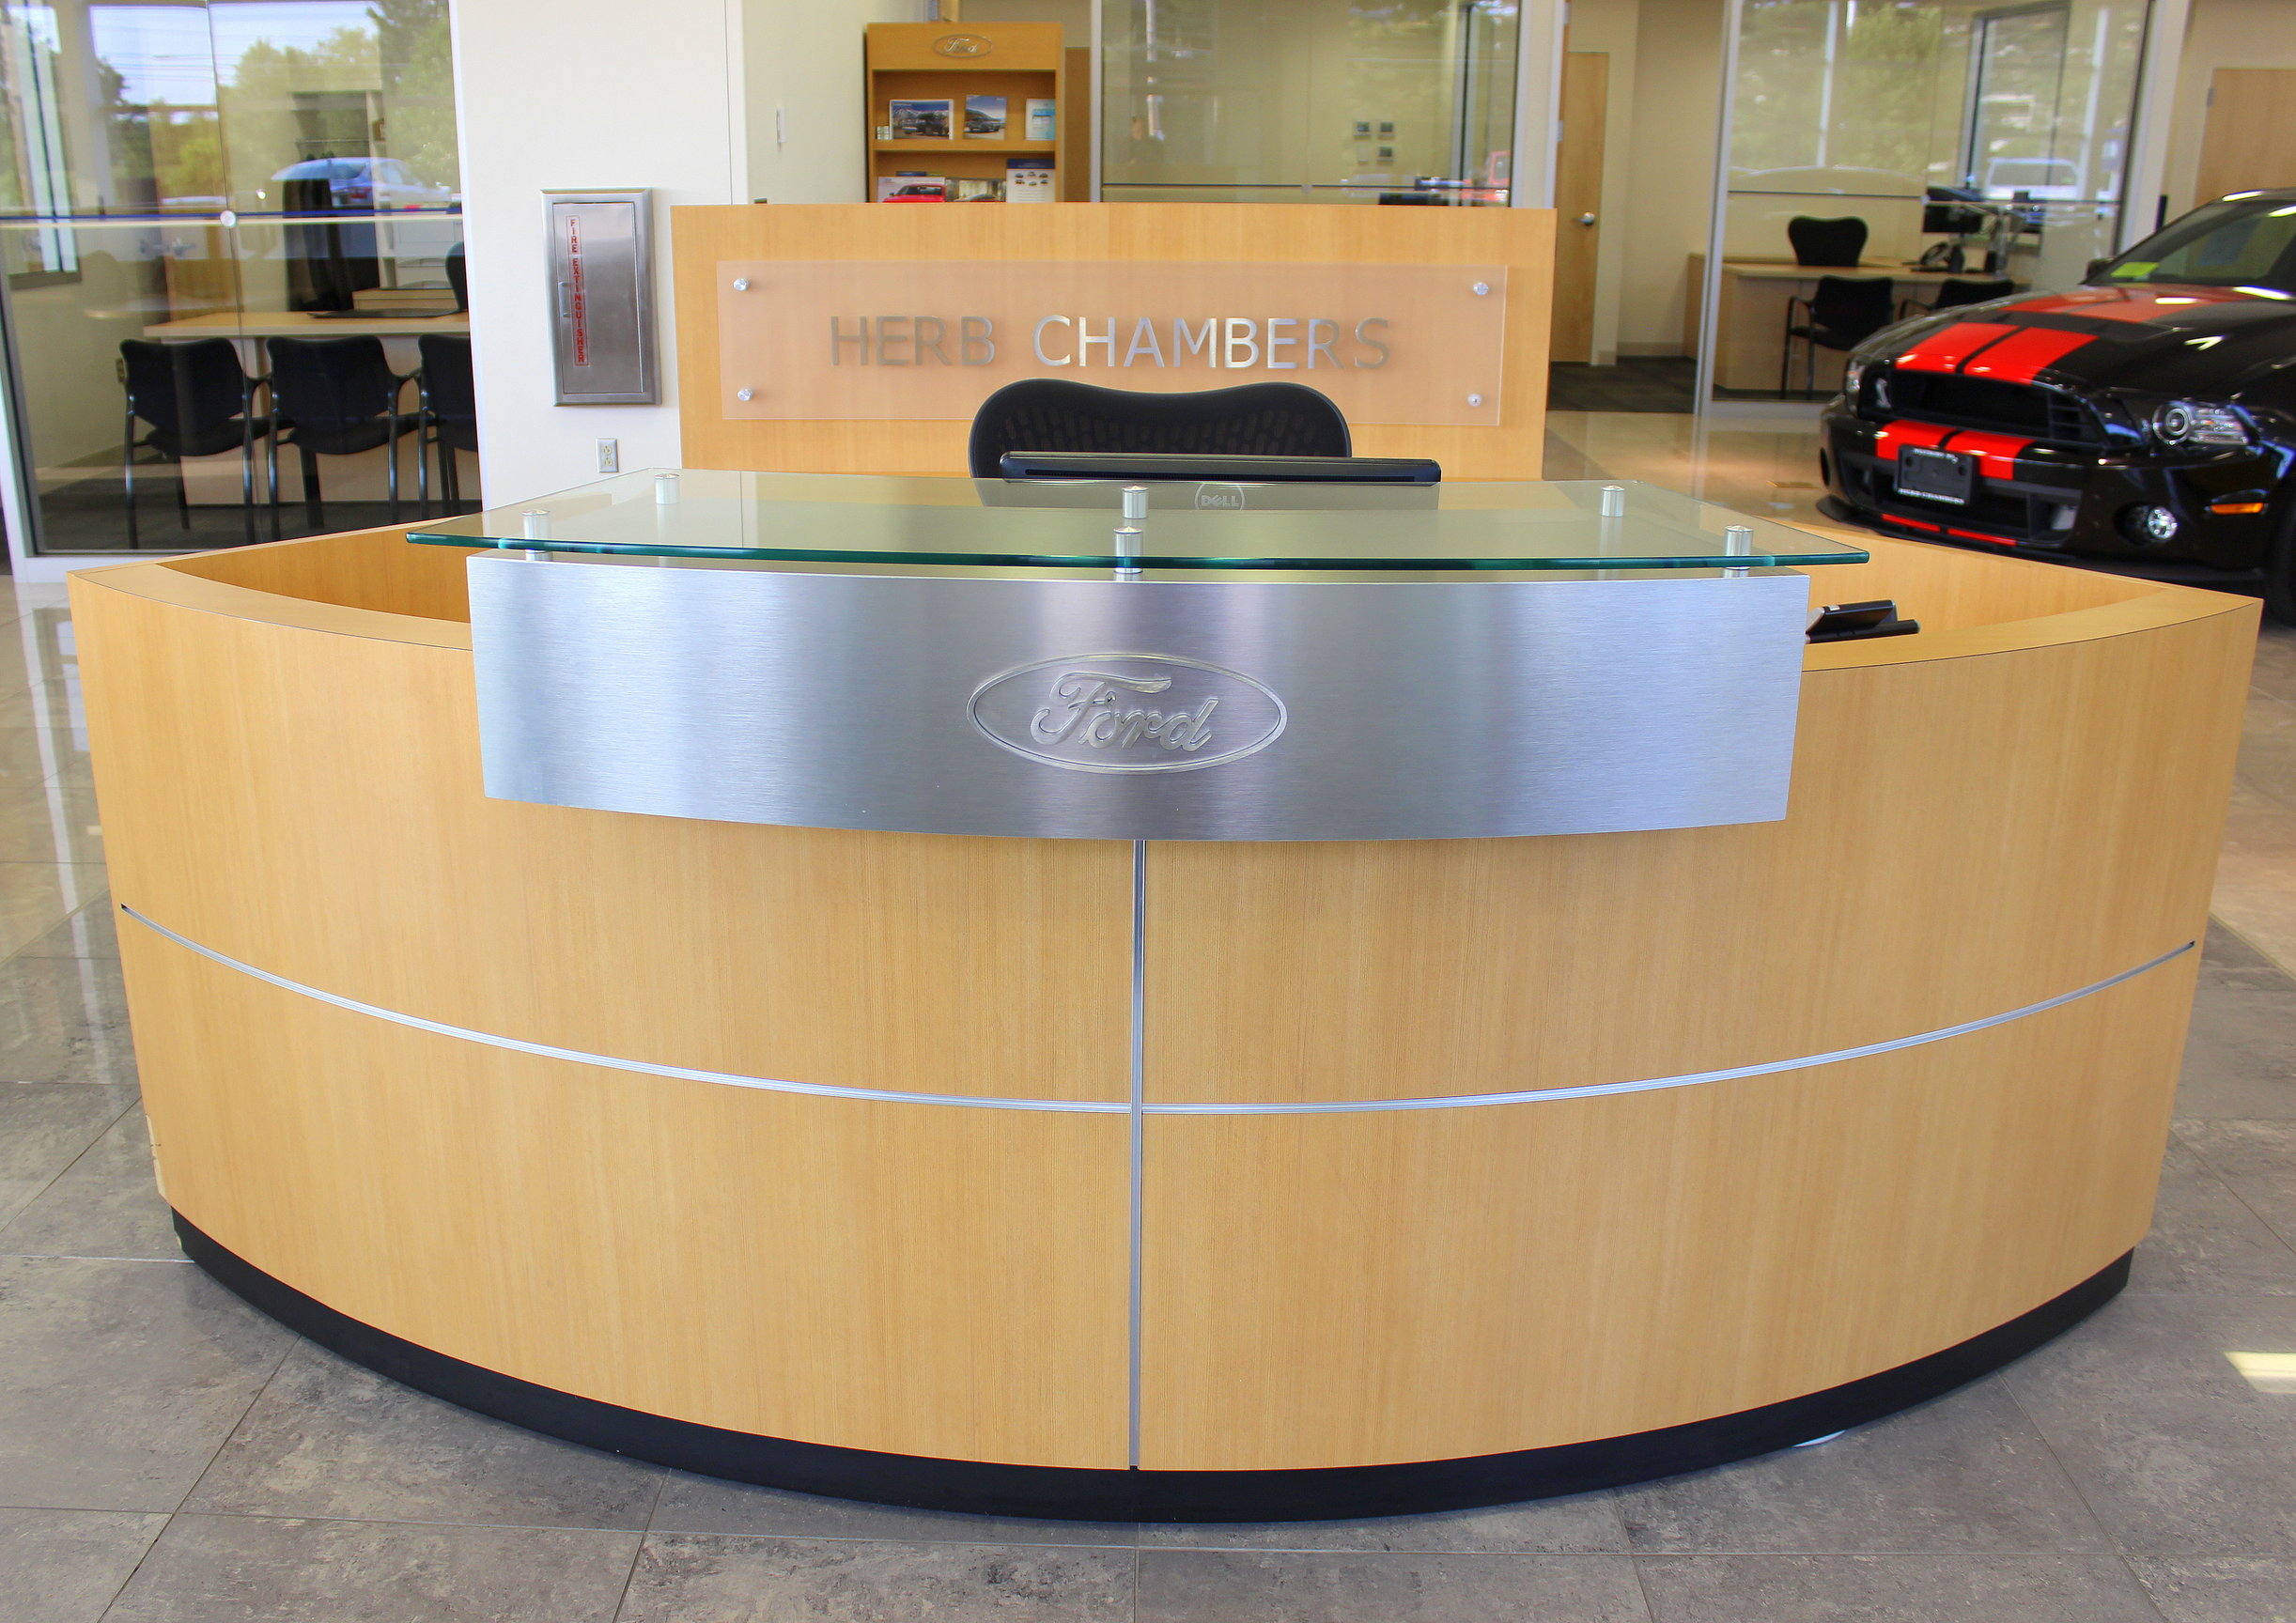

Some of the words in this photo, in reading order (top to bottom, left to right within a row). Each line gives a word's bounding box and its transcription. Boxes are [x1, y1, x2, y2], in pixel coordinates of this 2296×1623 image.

[572, 258, 585, 363] EXTINGUISHER
[830, 316, 996, 366] HERB
[1033, 314, 1390, 369] CHAMBERS
[1201, 494, 1239, 506] DELL
[1030, 671, 1218, 752] Ford
